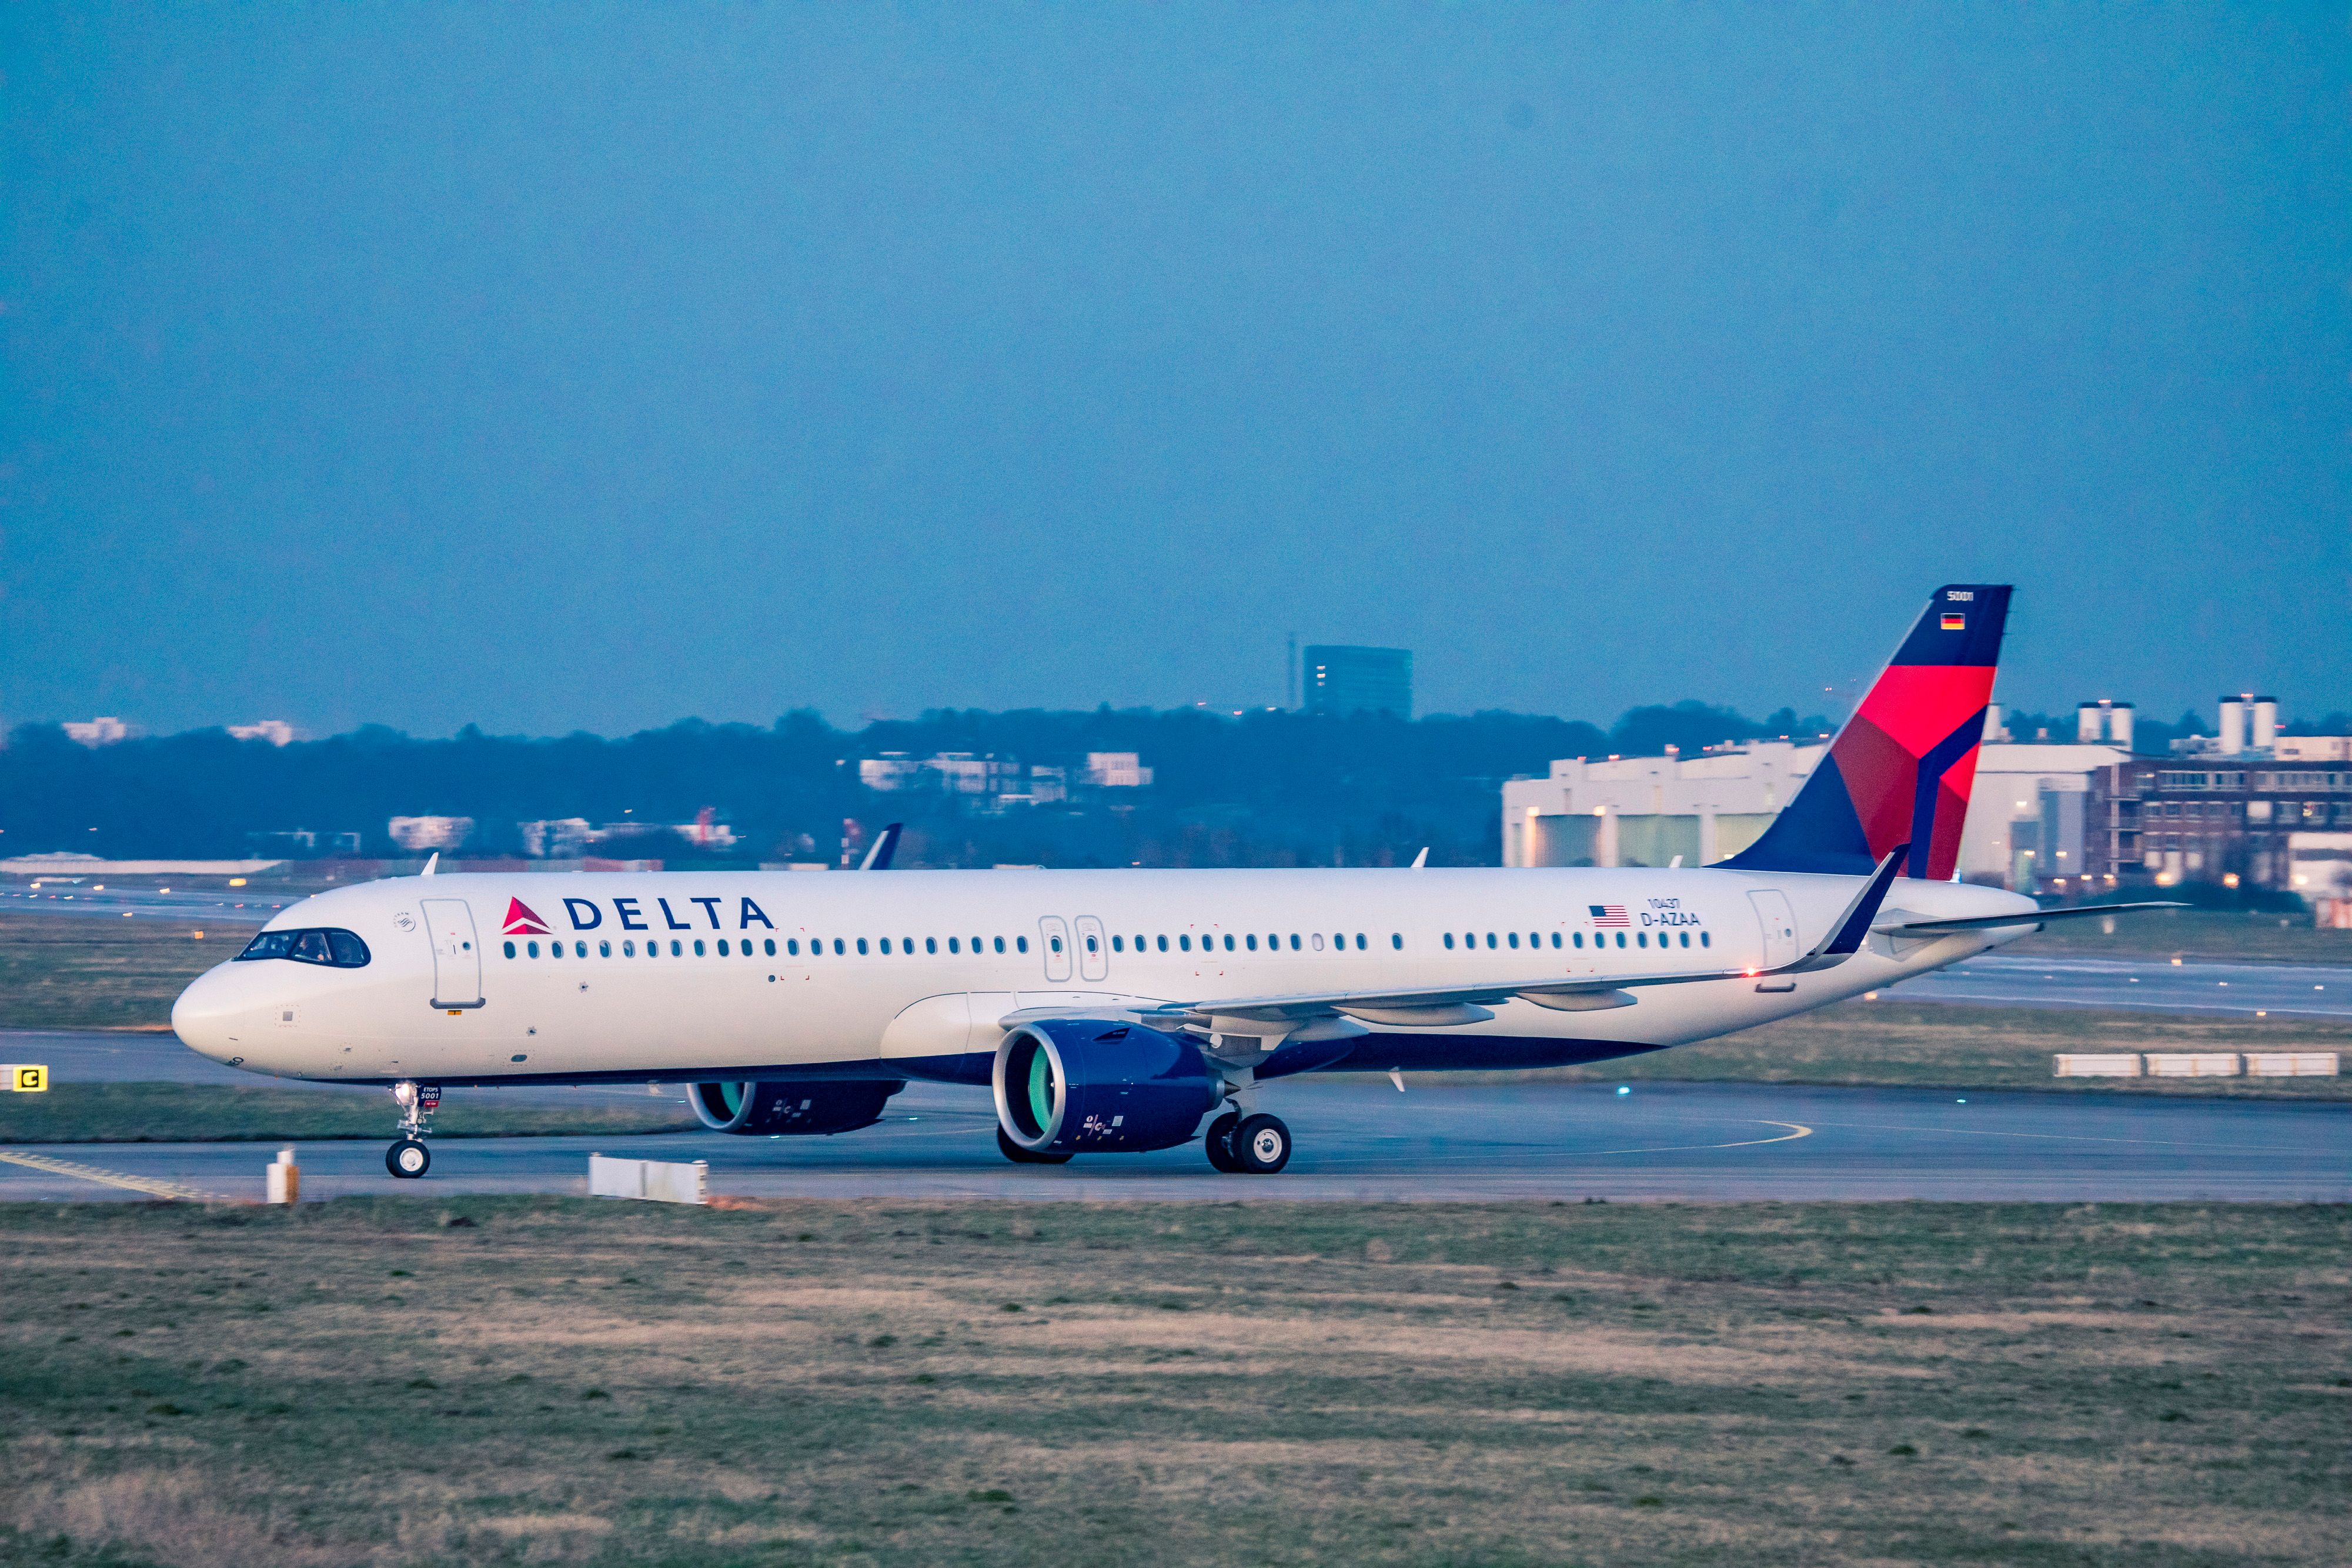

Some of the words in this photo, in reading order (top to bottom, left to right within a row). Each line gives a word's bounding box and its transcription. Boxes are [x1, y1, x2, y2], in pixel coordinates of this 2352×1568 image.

[1647, 898, 1681, 909] 10437
[562, 897, 774, 930] DELTA
[1640, 912, 1702, 926] D-AZAA
[22, 1071, 38, 1086] C
